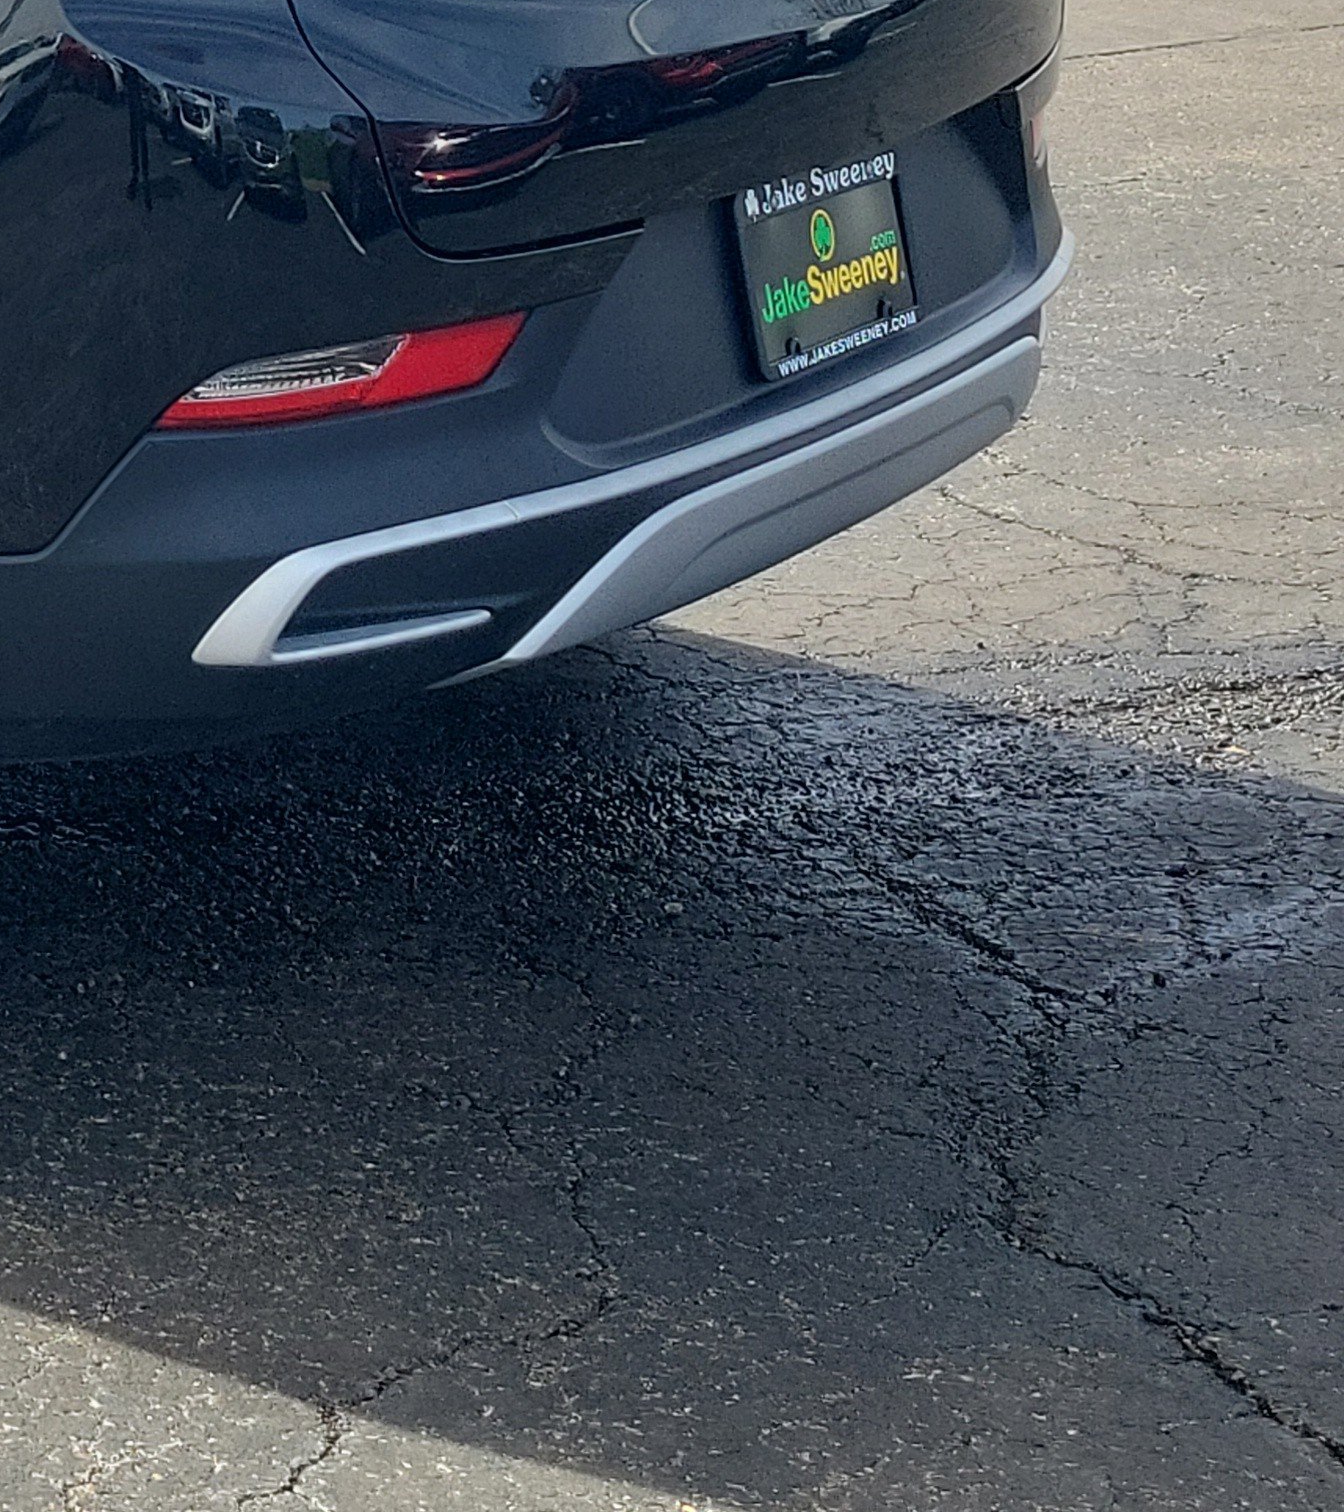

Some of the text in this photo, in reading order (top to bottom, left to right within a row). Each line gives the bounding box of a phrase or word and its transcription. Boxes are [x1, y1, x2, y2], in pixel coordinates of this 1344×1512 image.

[762, 177, 807, 214] Jake
[869, 230, 896, 252] .com
[762, 246, 899, 323] JakeSweeney
[778, 311, 917, 378] WWW.JAKESWEENEY.COM
